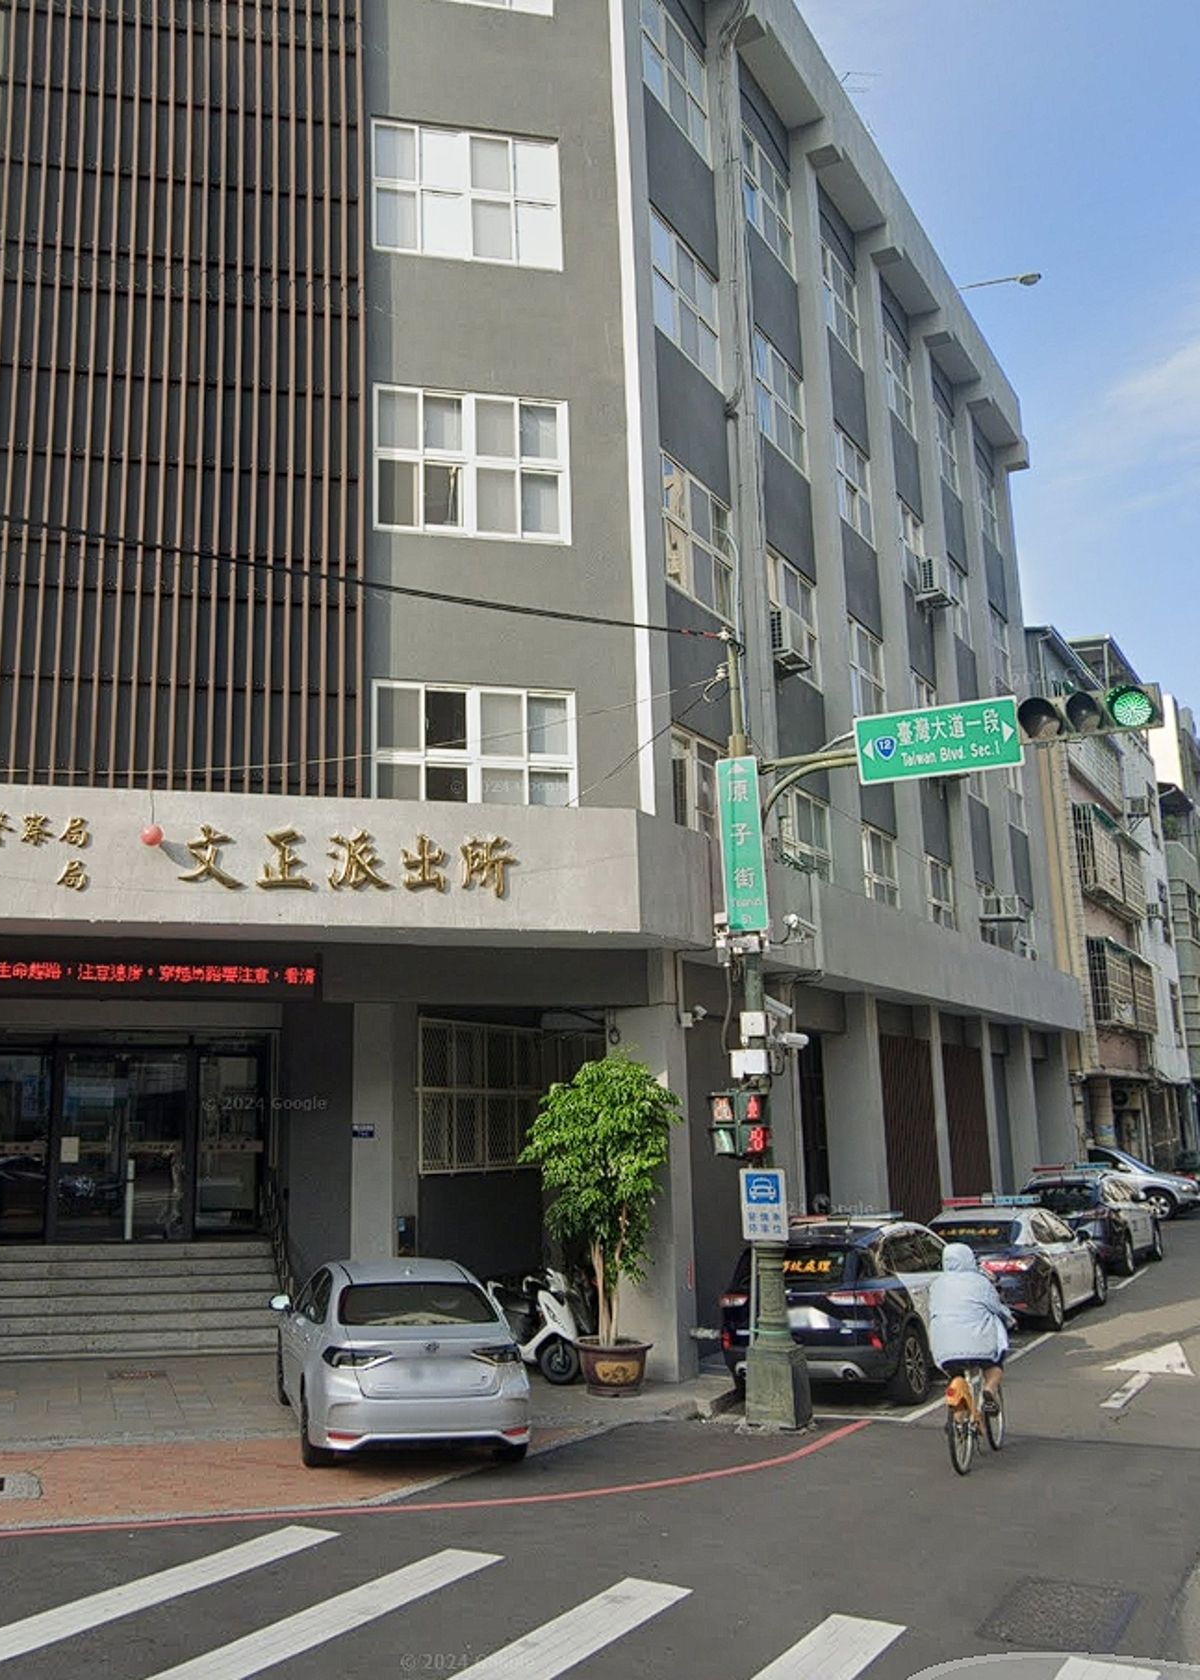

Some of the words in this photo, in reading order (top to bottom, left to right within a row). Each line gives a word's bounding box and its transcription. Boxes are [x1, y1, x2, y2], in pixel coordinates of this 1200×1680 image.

[879, 740, 892, 750] 12
[896, 708, 1001, 746] 臺灣大道一段
[901, 752, 937, 767] Taiwan
[940, 747, 967, 763] Blvd.
[728, 780, 756, 889] 原子街
[177, 824, 523, 900] 文正派出所
